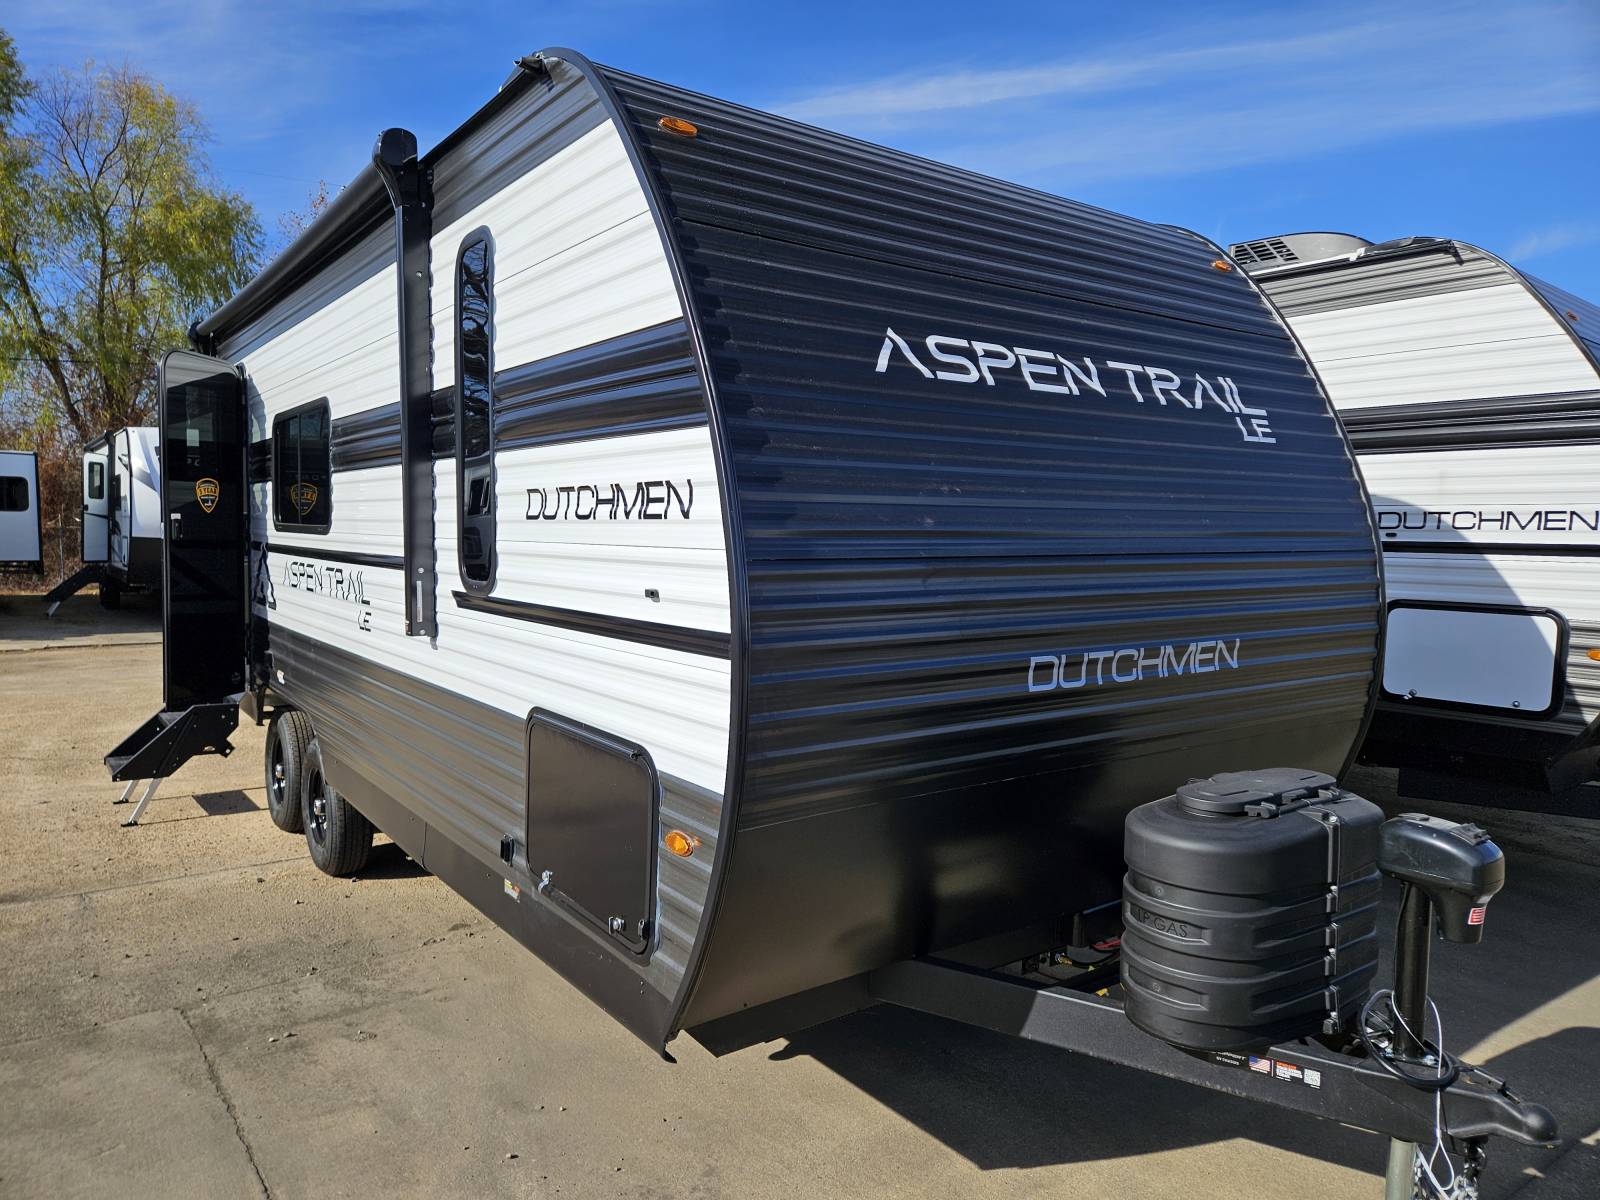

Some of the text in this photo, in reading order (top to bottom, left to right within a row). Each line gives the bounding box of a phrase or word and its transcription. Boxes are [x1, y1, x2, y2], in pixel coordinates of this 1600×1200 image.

[875, 327, 1268, 416] ASPEN TRAIL
[1235, 416, 1277, 444] LE
[526, 479, 693, 520] DUTCHMEN
[1378, 510, 1600, 531] DUTCHMEN
[283, 560, 371, 605] ASPEN TRAIL
[358, 610, 372, 632] LE
[1028, 638, 1240, 692] DUTCHMEN
[1153, 917, 1188, 938] GAS
